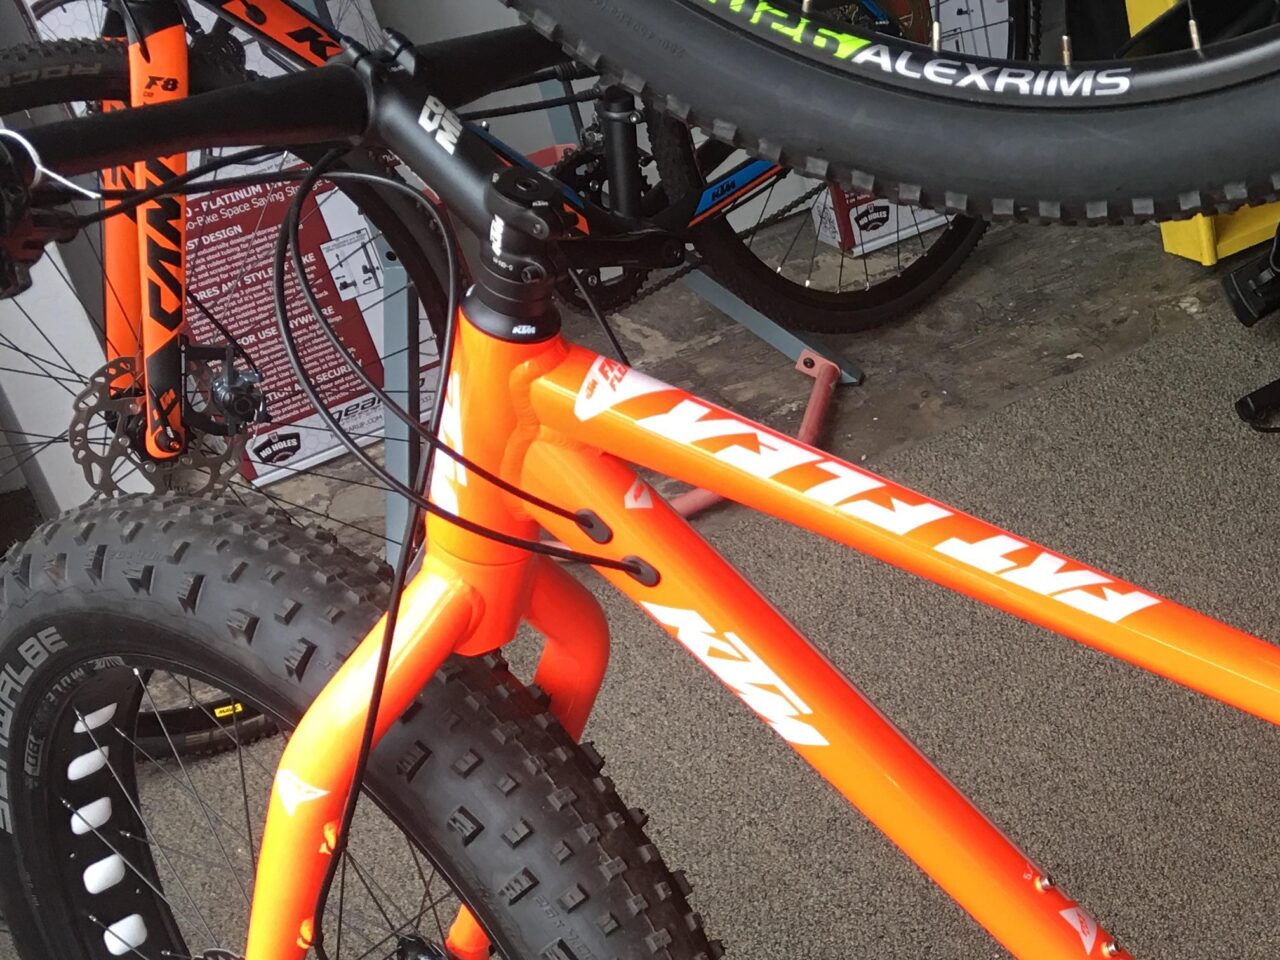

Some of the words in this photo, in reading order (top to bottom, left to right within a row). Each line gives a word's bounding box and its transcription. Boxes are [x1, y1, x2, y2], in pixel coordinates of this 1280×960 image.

[852, 44, 1132, 96] ALEXRIMS
[145, 76, 179, 92] F8
[201, 184, 263, 212] PLATINUM
[219, 201, 251, 220] Space
[201, 225, 243, 245] DESIGN
[257, 327, 278, 340] USE
[271, 438, 298, 453] HOLES
[638, 600, 831, 747] KTM
